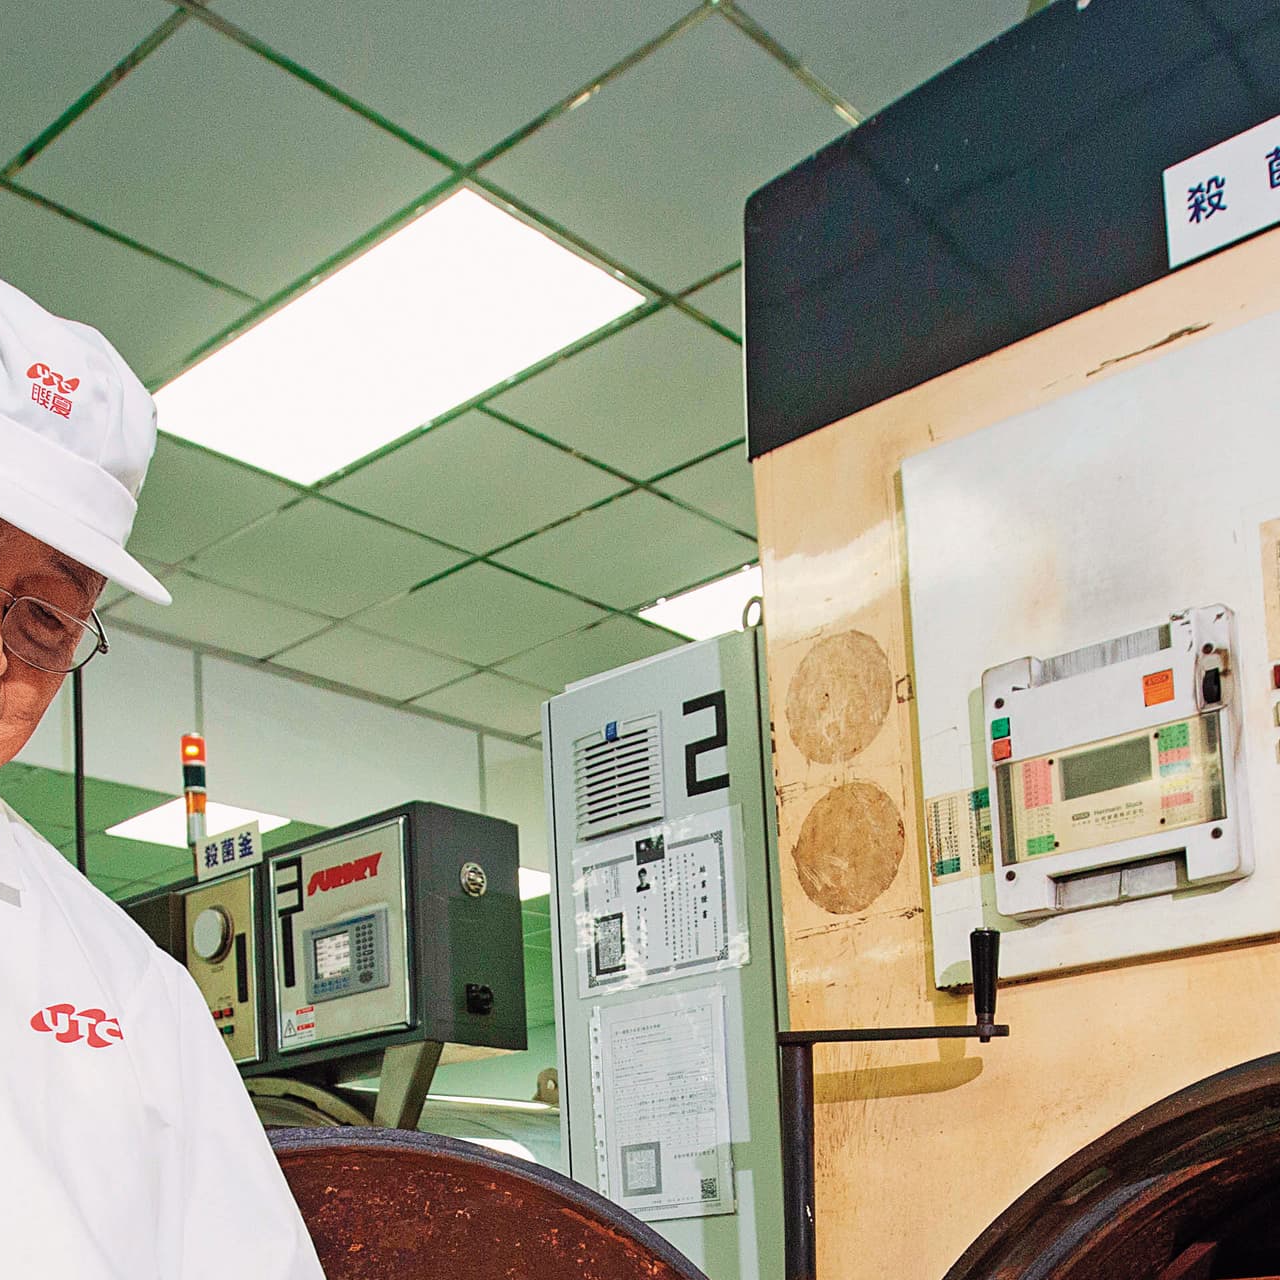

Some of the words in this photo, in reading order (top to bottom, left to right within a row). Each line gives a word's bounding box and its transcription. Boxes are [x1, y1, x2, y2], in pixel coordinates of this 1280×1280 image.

[682, 689, 730, 797] 2
[204, 831, 254, 868] 殺菌釜
